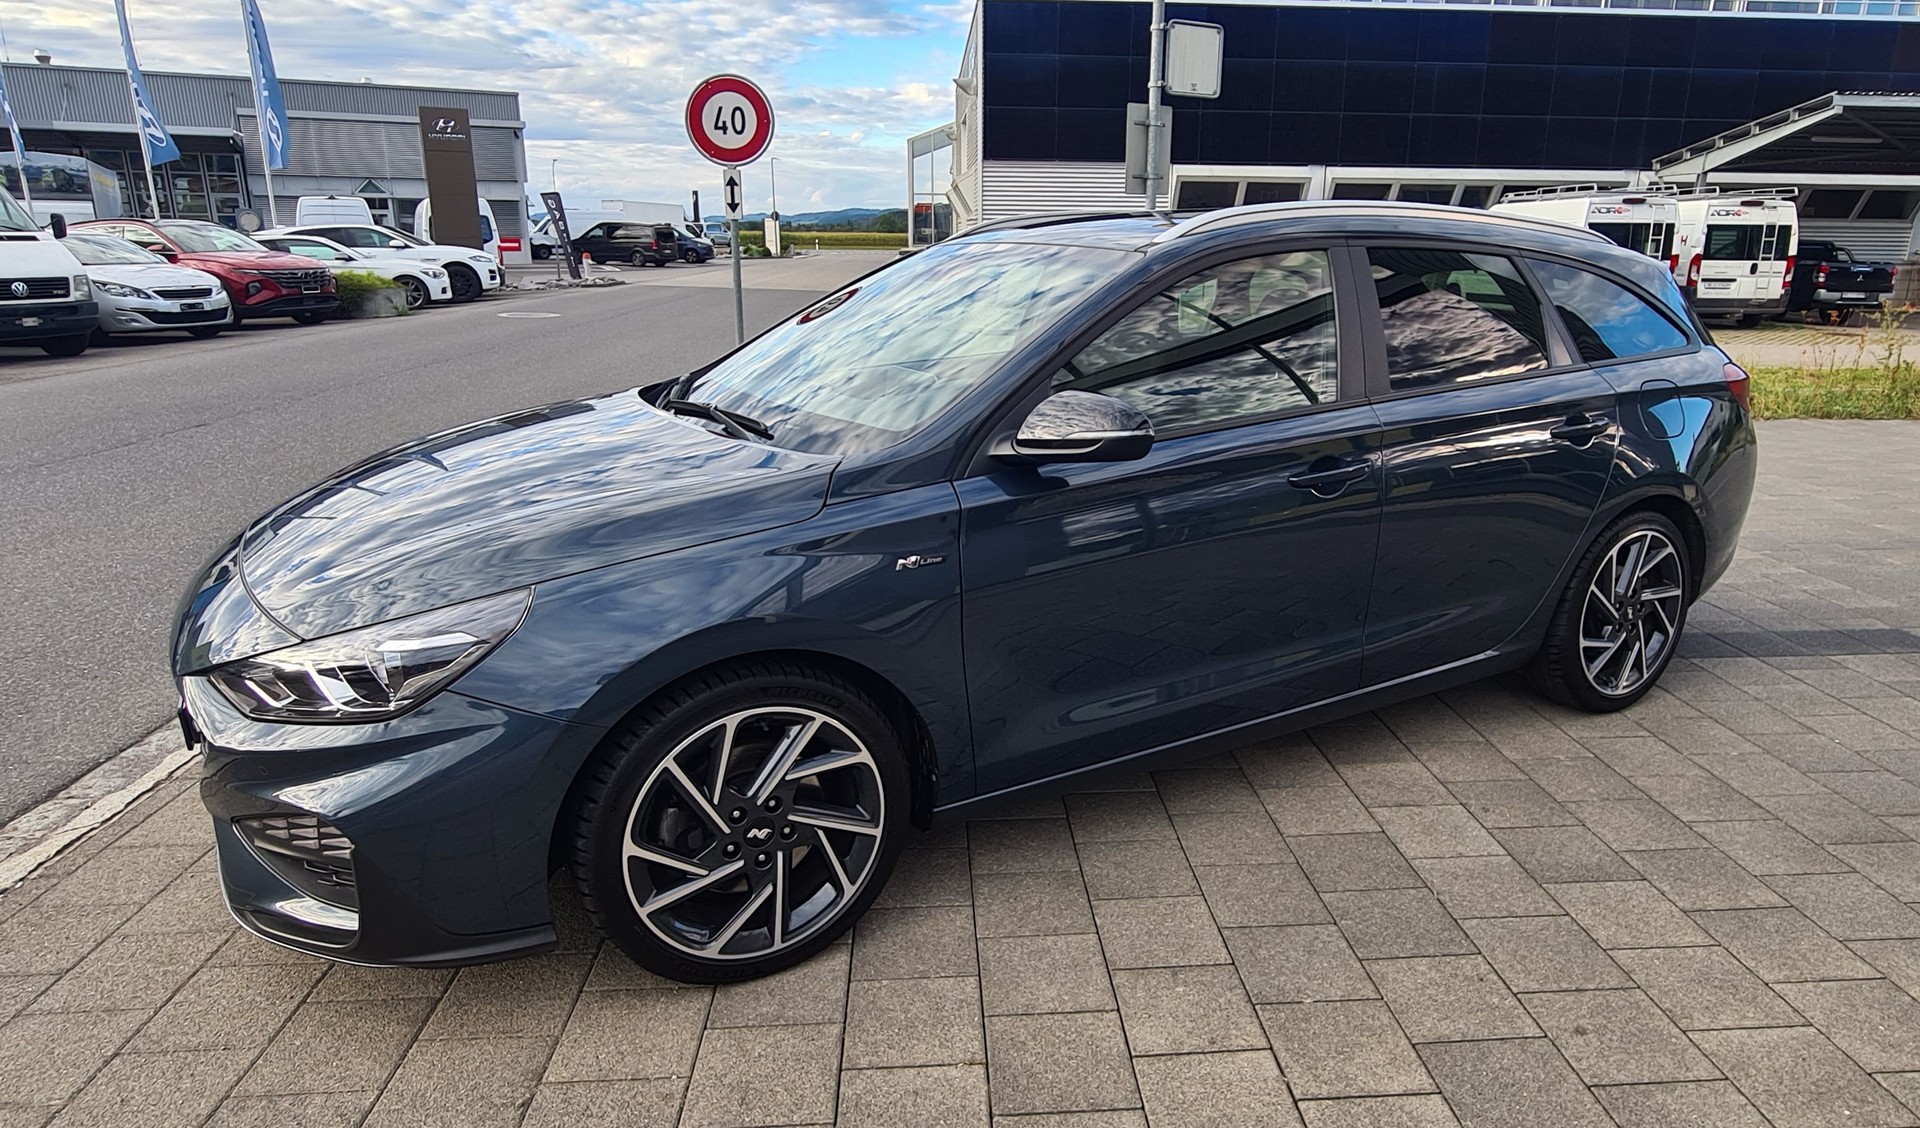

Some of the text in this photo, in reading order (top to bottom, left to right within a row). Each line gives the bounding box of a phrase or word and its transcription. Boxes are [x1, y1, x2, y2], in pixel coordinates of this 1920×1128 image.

[714, 106, 746, 135] 40
[920, 557, 943, 565] Line
[767, 687, 841, 709] MICHELIN
